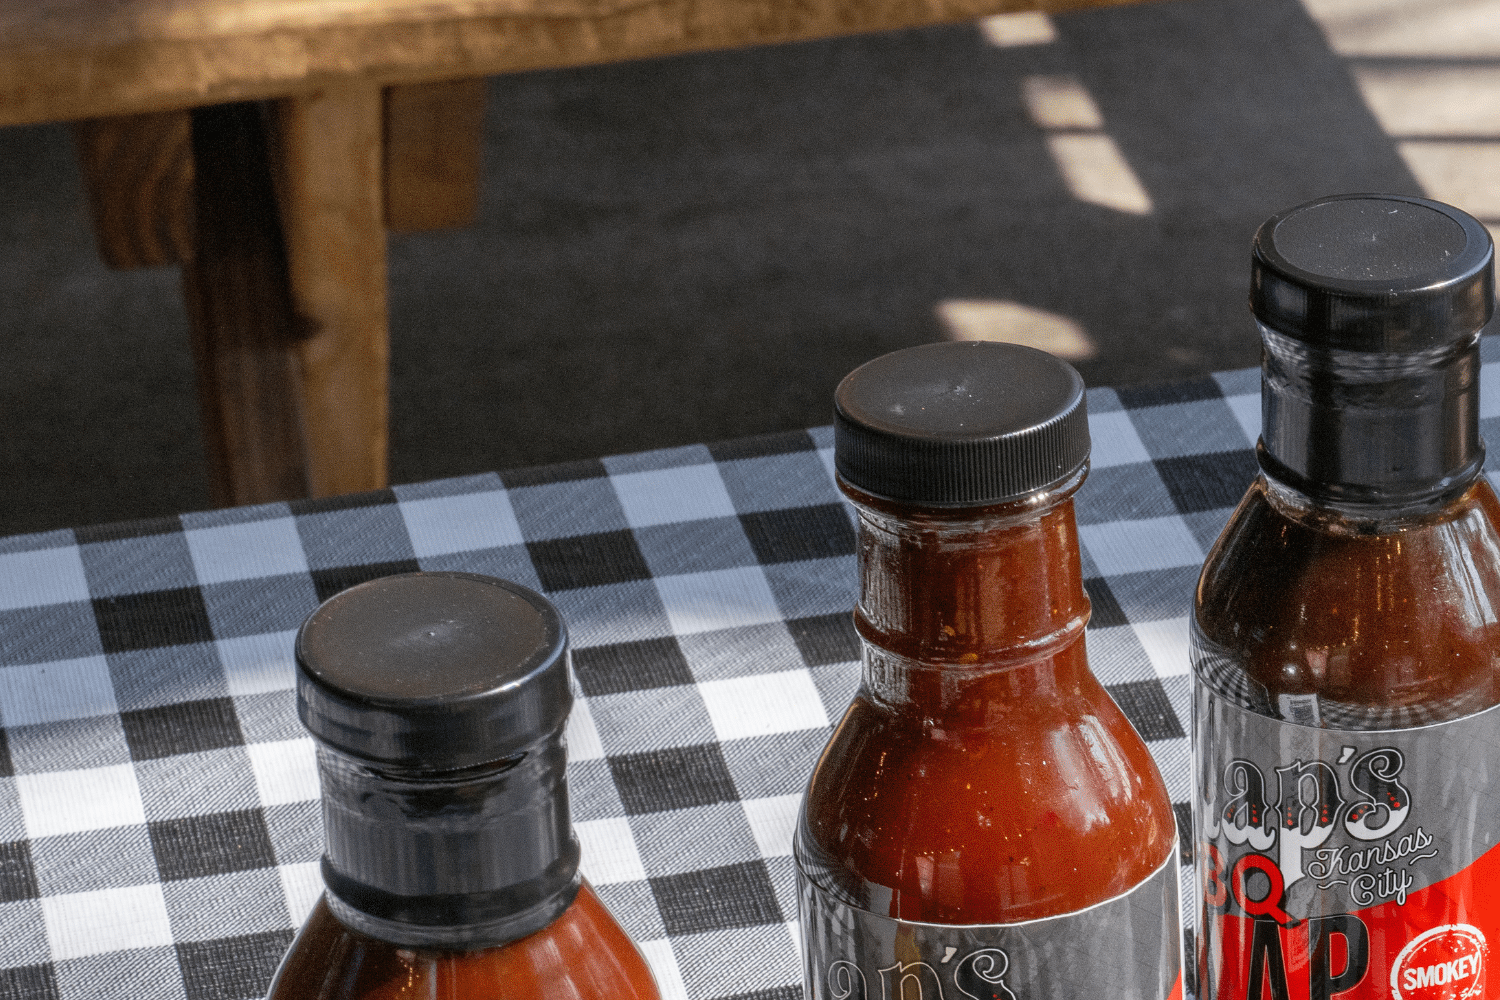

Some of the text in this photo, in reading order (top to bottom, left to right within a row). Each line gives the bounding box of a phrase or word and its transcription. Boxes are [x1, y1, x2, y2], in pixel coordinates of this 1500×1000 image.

[1202, 712, 1410, 890] lap's
[1308, 827, 1433, 880] Kansas
[1202, 842, 1302, 929] BQ
[1350, 867, 1413, 906] City
[1403, 953, 1480, 991] SMOKEY
